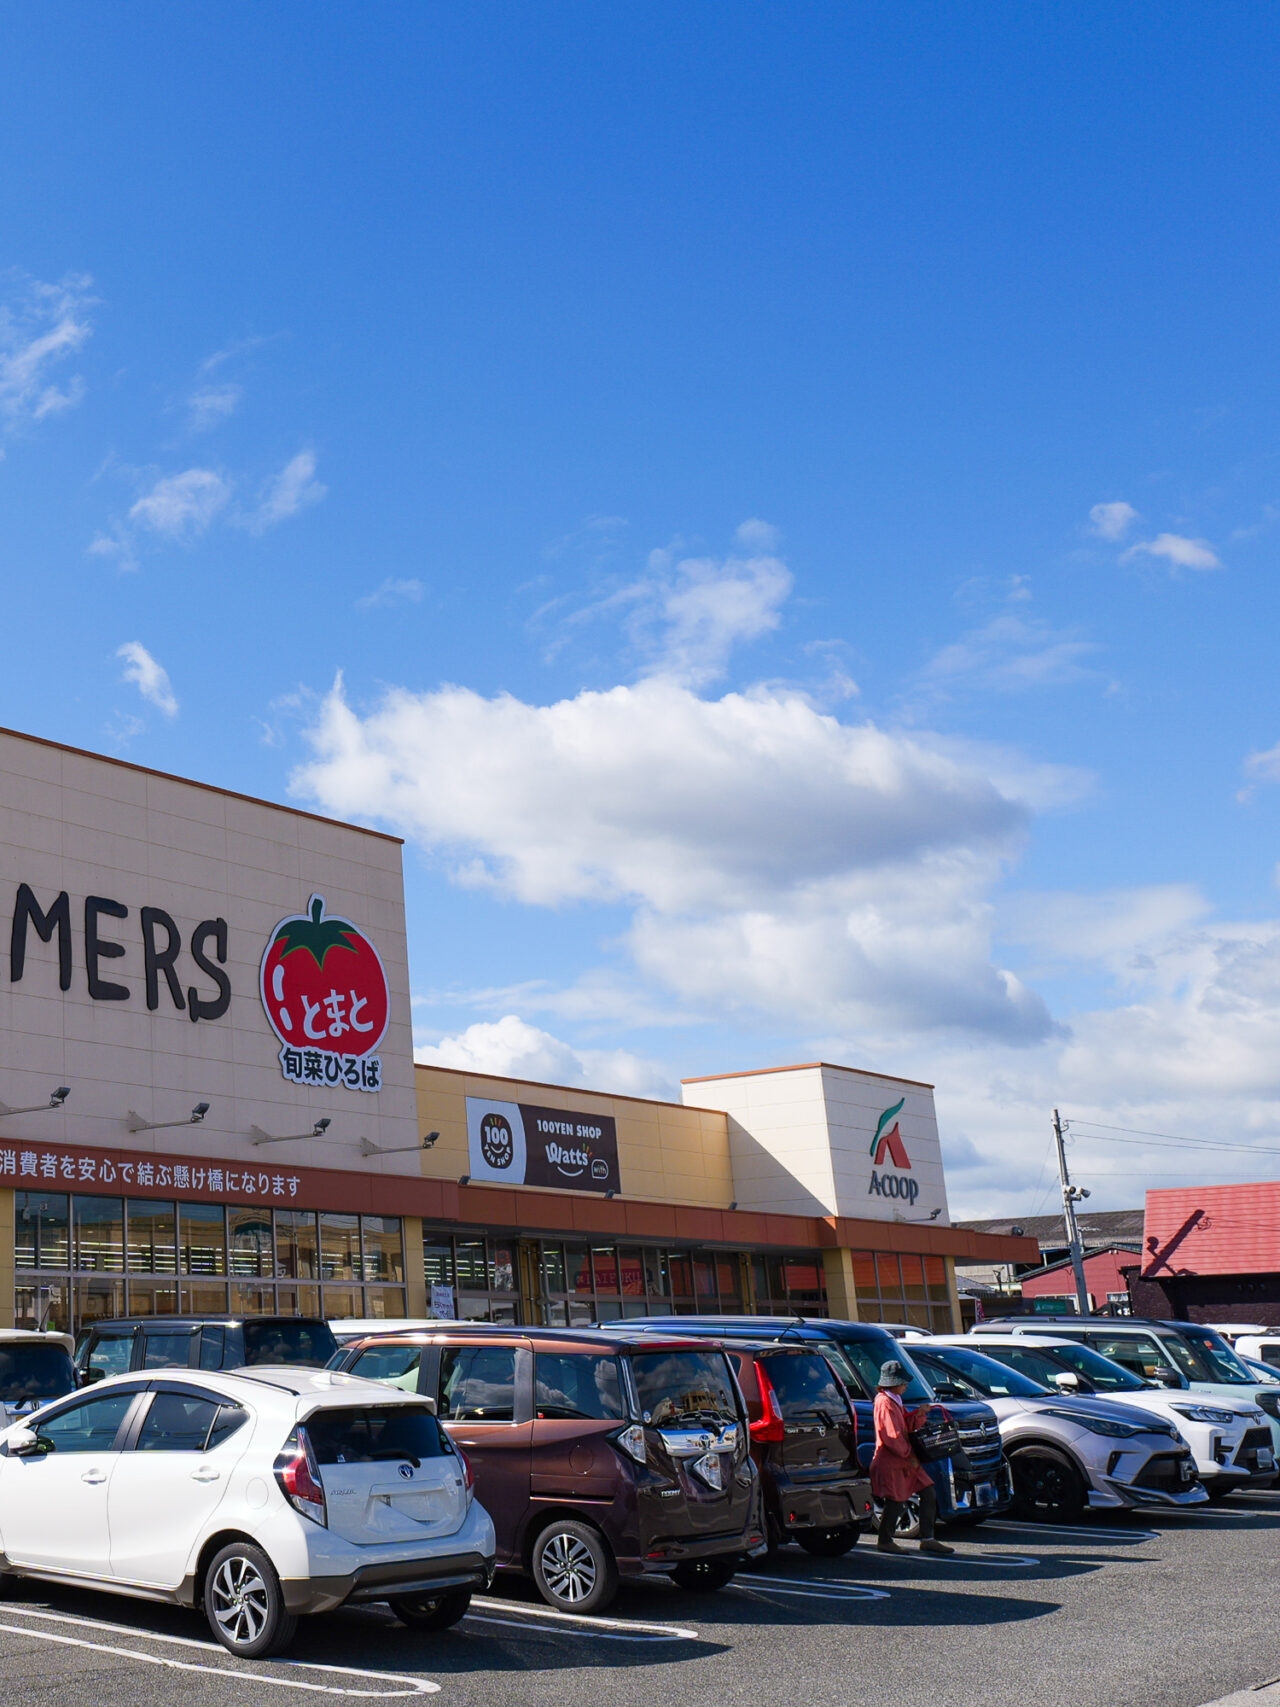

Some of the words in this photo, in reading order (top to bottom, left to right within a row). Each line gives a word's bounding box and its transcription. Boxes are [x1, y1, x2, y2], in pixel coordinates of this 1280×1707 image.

[300, 988, 374, 1040] とまと
[283, 1047, 380, 1088] 旬菜ひろば
[484, 1126, 509, 1146] 100
[536, 1119, 574, 1136] 100YEN
[576, 1124, 602, 1140] SHOP
[545, 1141, 589, 1166] Watts
